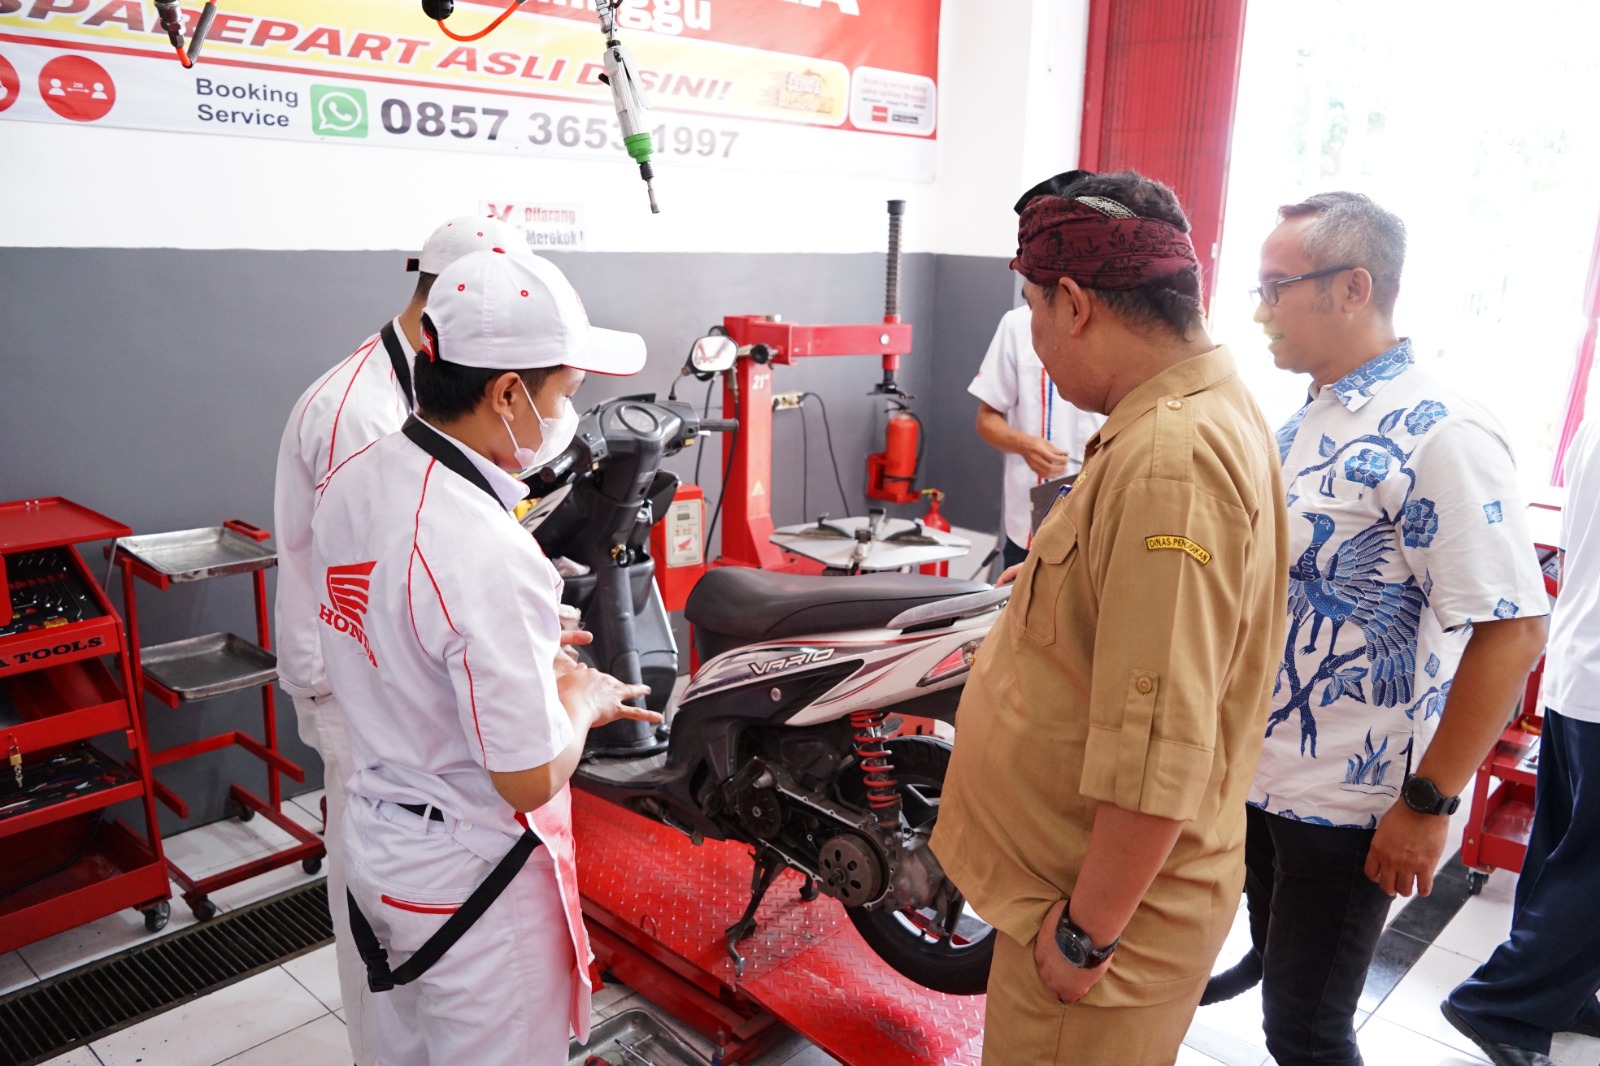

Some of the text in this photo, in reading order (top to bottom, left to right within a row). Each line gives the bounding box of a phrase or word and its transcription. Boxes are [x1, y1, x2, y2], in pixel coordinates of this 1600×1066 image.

[436, 46, 567, 81] ASLI
[577, 62, 732, 100] DSINI!!
[196, 78, 298, 108] Booking
[197, 104, 289, 127] Service
[381, 98, 509, 141] 0857
[652, 124, 739, 158] 1997
[1149, 538, 1209, 562] DINAS PENDIDIKAN
[13, 636, 103, 664] TOOLS
[319, 603, 378, 668] HONDA
[749, 648, 836, 675] VARIO
